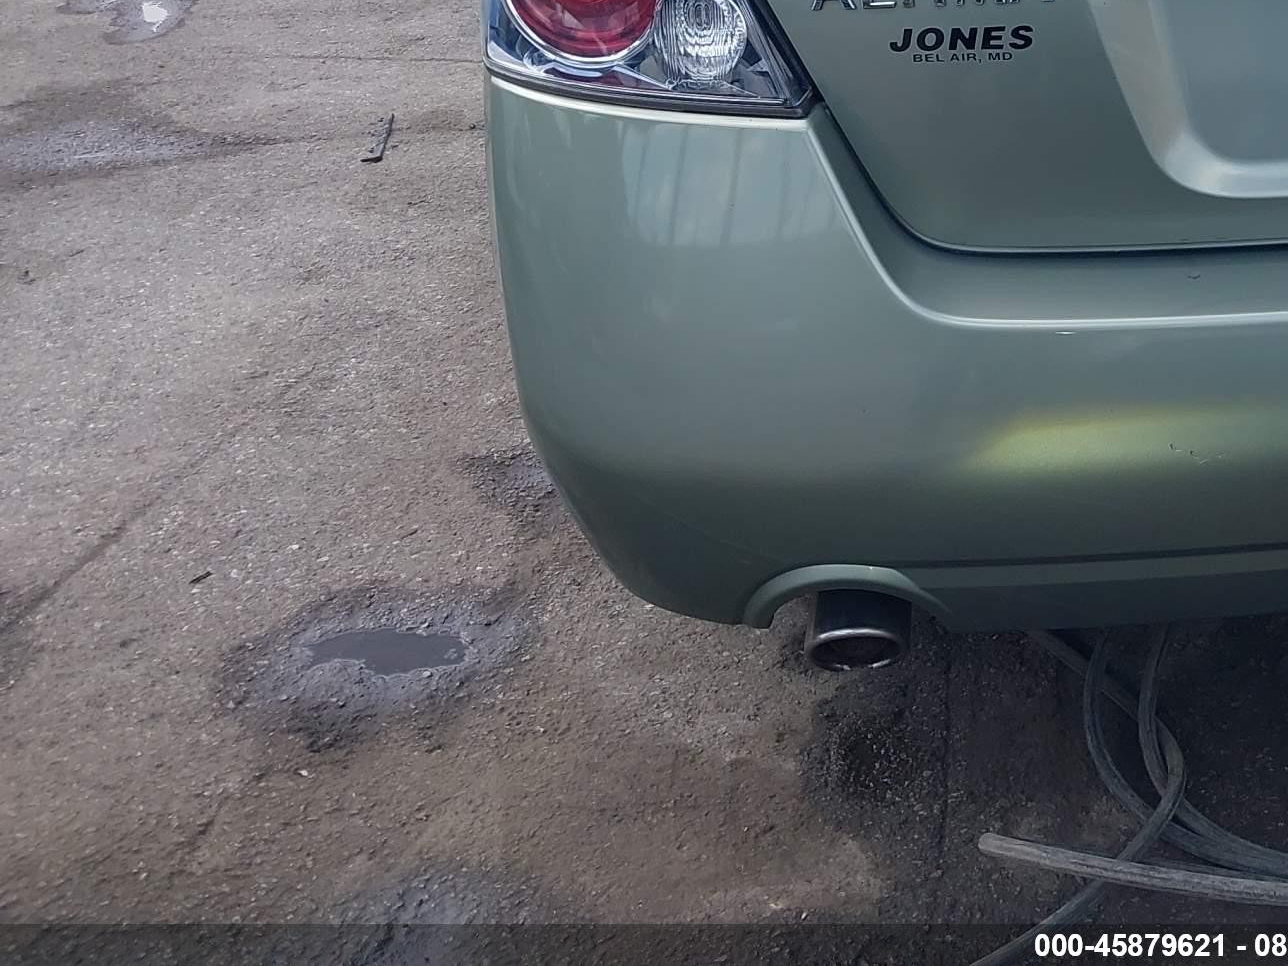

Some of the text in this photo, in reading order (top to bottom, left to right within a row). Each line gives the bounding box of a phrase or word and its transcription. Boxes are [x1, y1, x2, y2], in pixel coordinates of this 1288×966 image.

[889, 25, 1034, 52] JONES
[912, 51, 1013, 64] BEL AIR, MD
